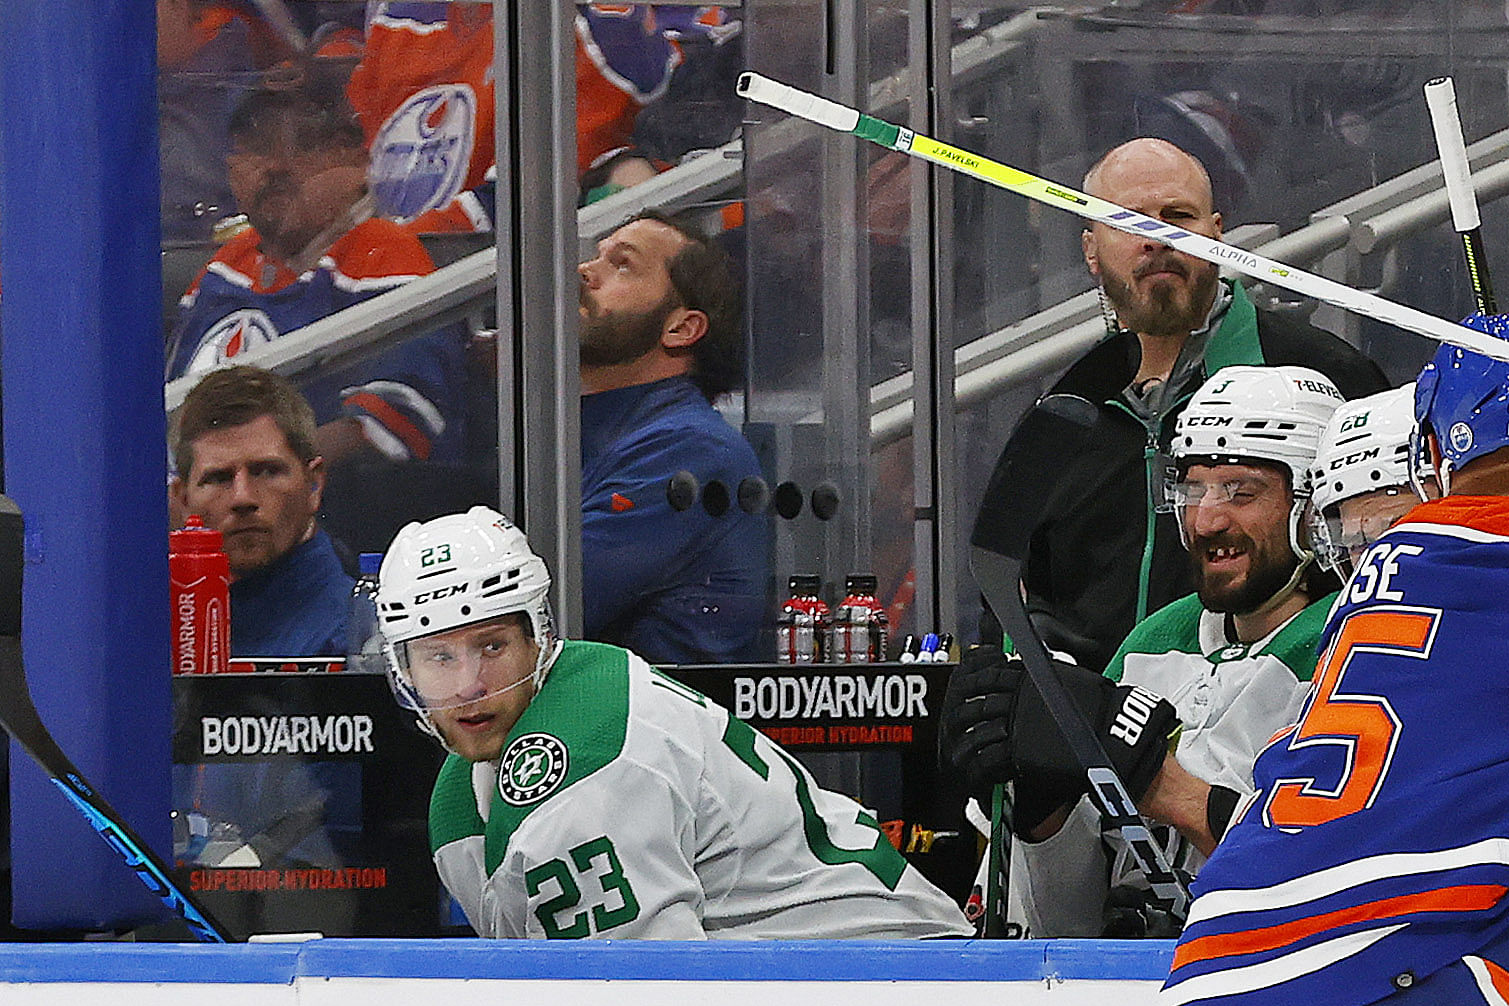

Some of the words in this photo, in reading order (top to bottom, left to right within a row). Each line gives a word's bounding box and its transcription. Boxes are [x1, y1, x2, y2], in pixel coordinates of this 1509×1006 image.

[1209, 246, 1257, 269] ALPHA
[1187, 416, 1234, 426] CCM
[1330, 447, 1381, 471] CCM
[421, 543, 452, 568] 23
[414, 582, 469, 605] CCM
[734, 675, 929, 719] BODYARMOR
[202, 715, 375, 755] BODYARMOR
[829, 725, 913, 744] HYDRATION
[190, 871, 280, 891] SUPERIOR
[284, 868, 387, 890] HYDRATION
[525, 836, 641, 940] 23
